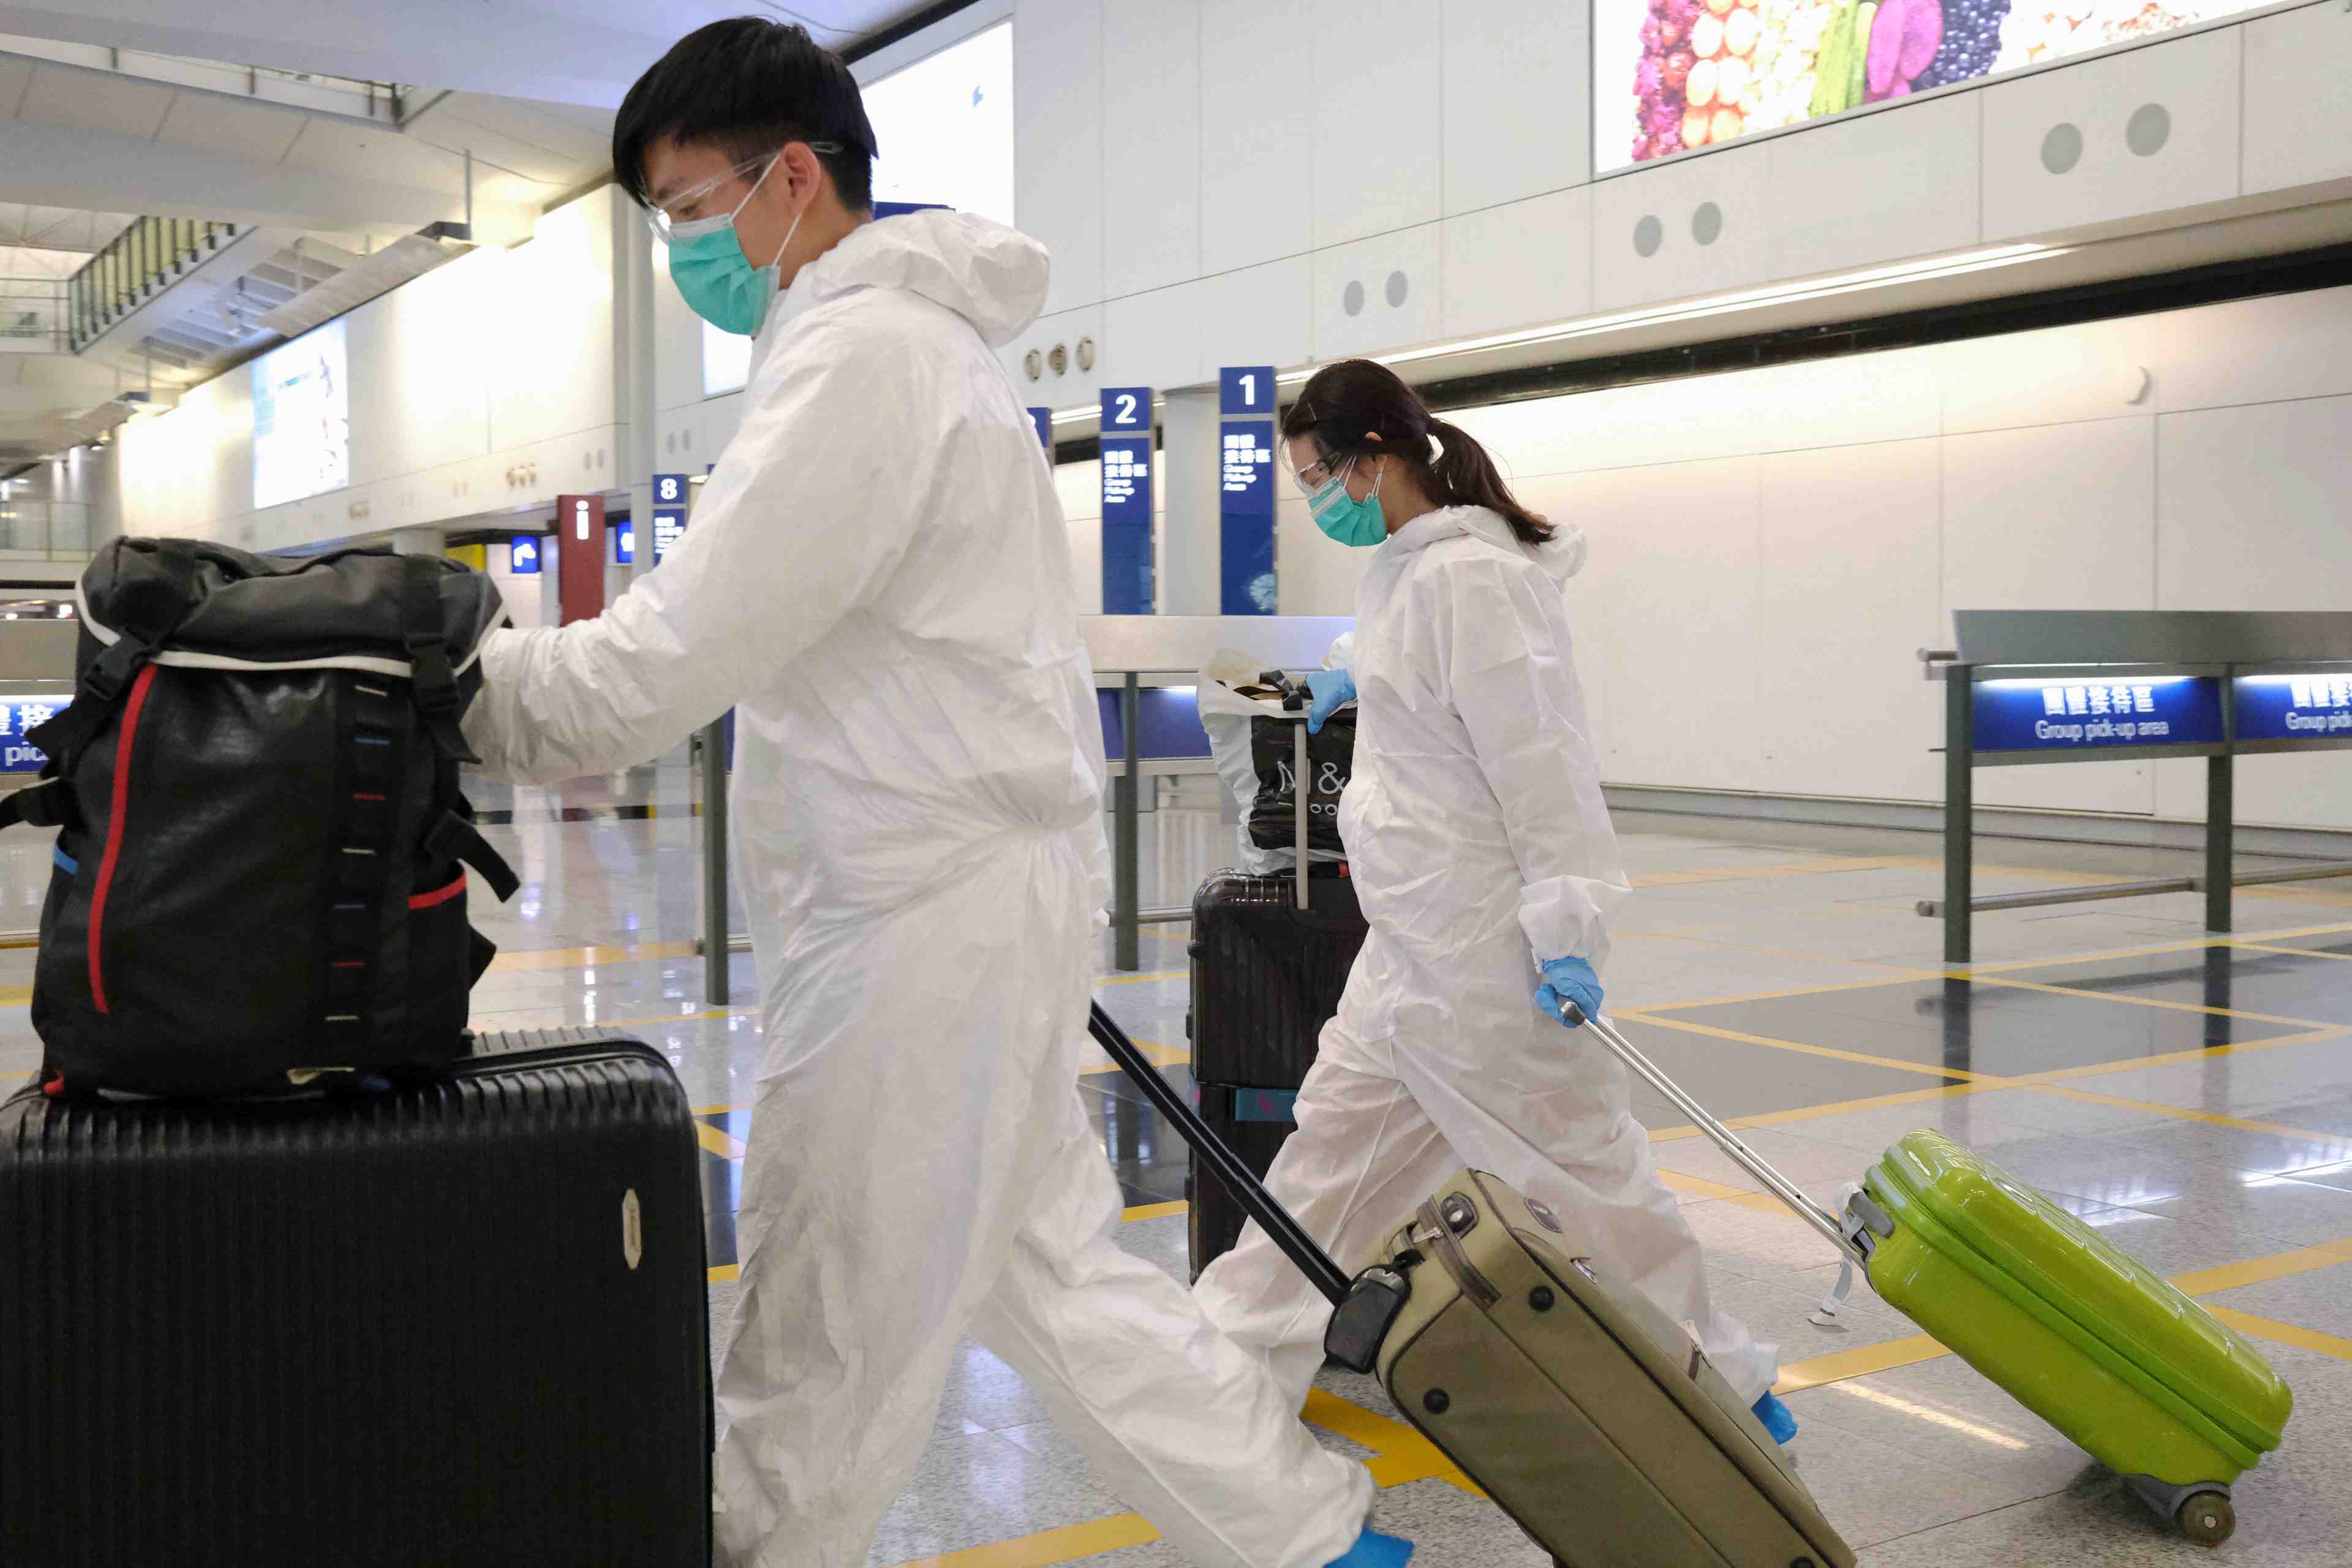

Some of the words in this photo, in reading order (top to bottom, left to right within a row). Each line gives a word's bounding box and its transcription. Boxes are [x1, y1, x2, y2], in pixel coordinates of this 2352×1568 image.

[1239, 375, 1254, 405] 1
[1115, 394, 1137, 423] 2
[661, 478, 677, 499] 8
[2035, 720, 2083, 742] Group
[2084, 718, 2136, 741] pick-up
[2138, 721, 2169, 736] area
[5, 741, 50, 766] pic
